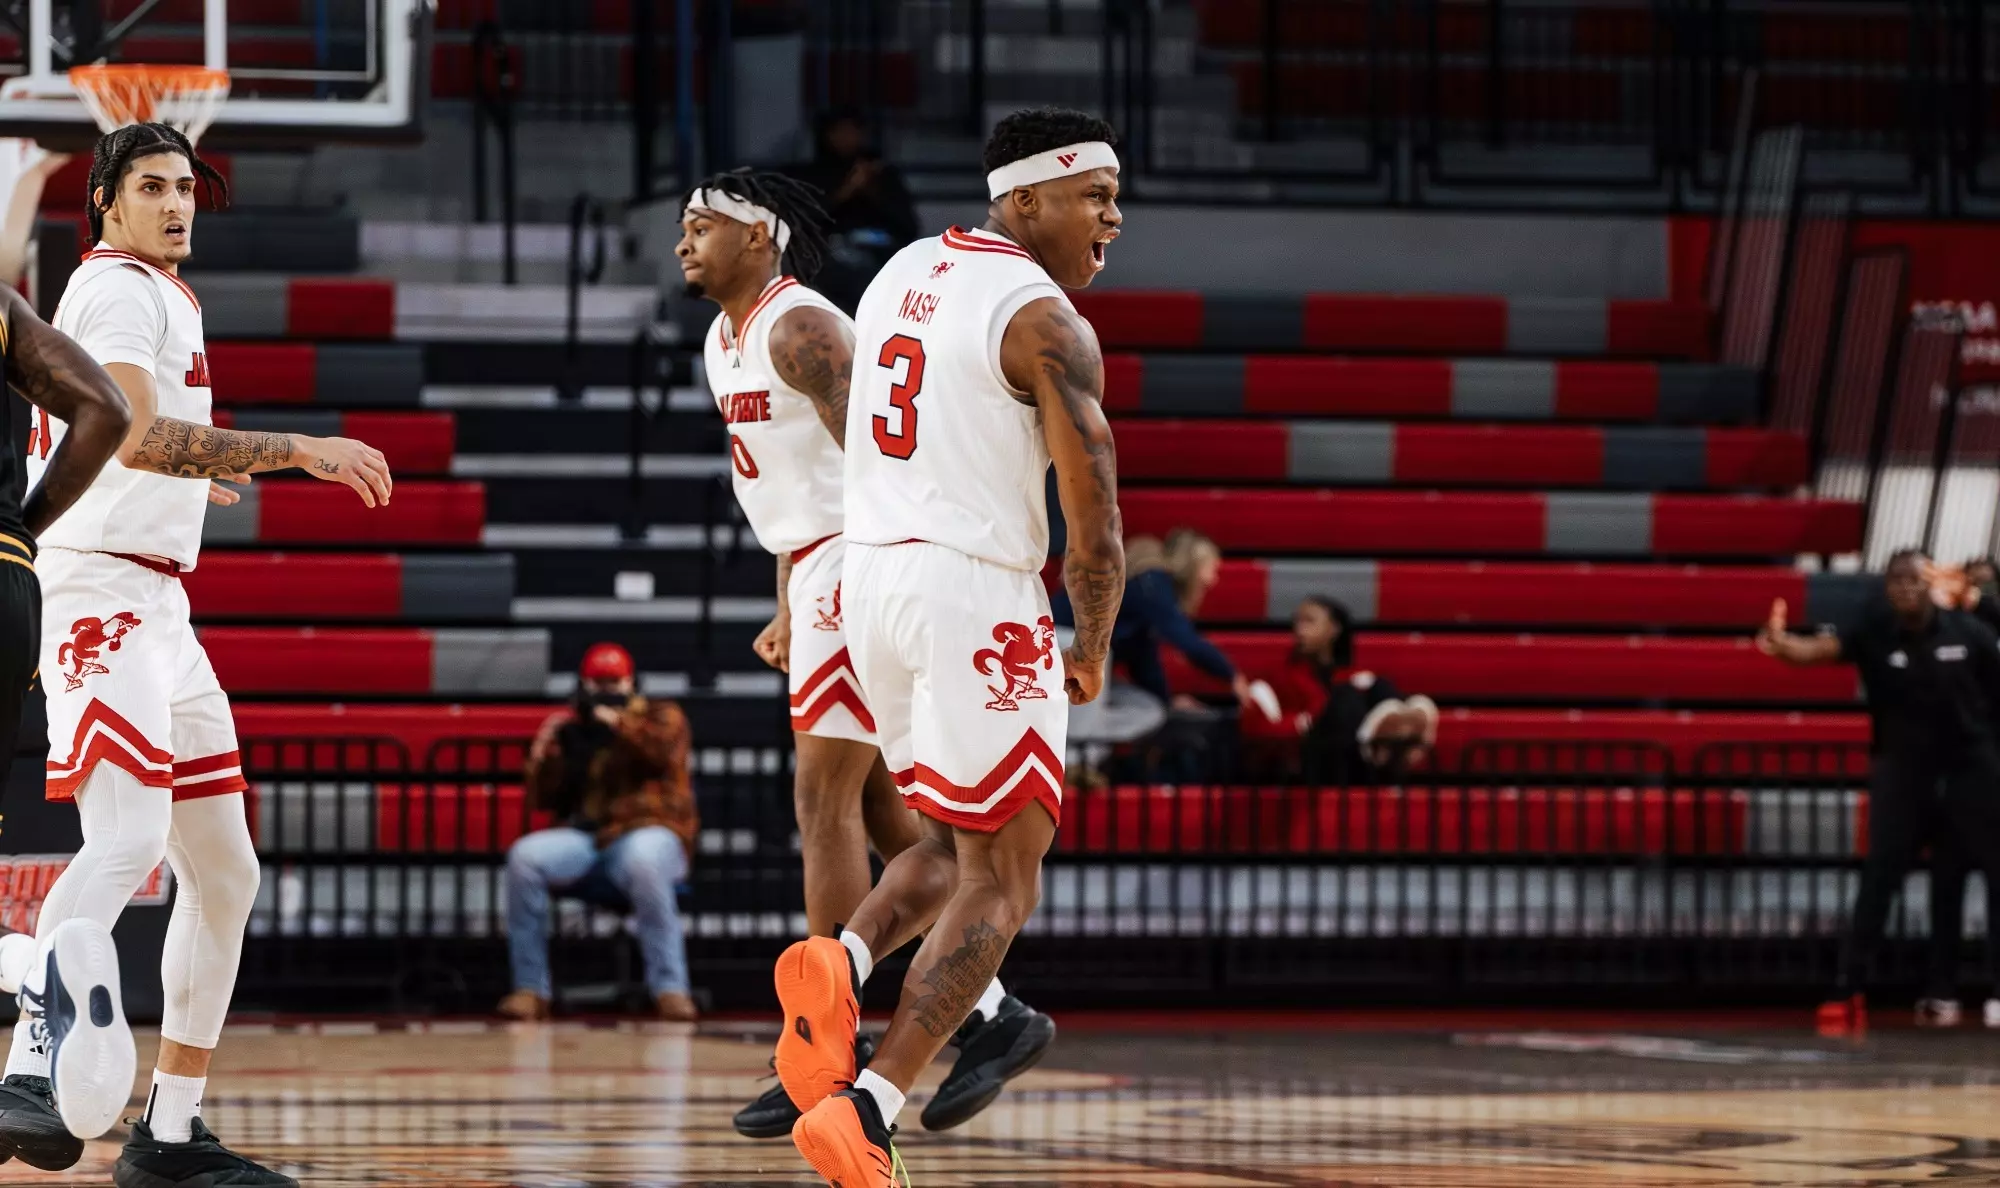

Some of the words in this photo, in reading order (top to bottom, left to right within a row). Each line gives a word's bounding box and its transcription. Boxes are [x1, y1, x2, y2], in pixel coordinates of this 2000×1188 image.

[898, 288, 941, 325] NASH
[872, 333, 926, 461] 3
[200, 430, 215, 451] Out
